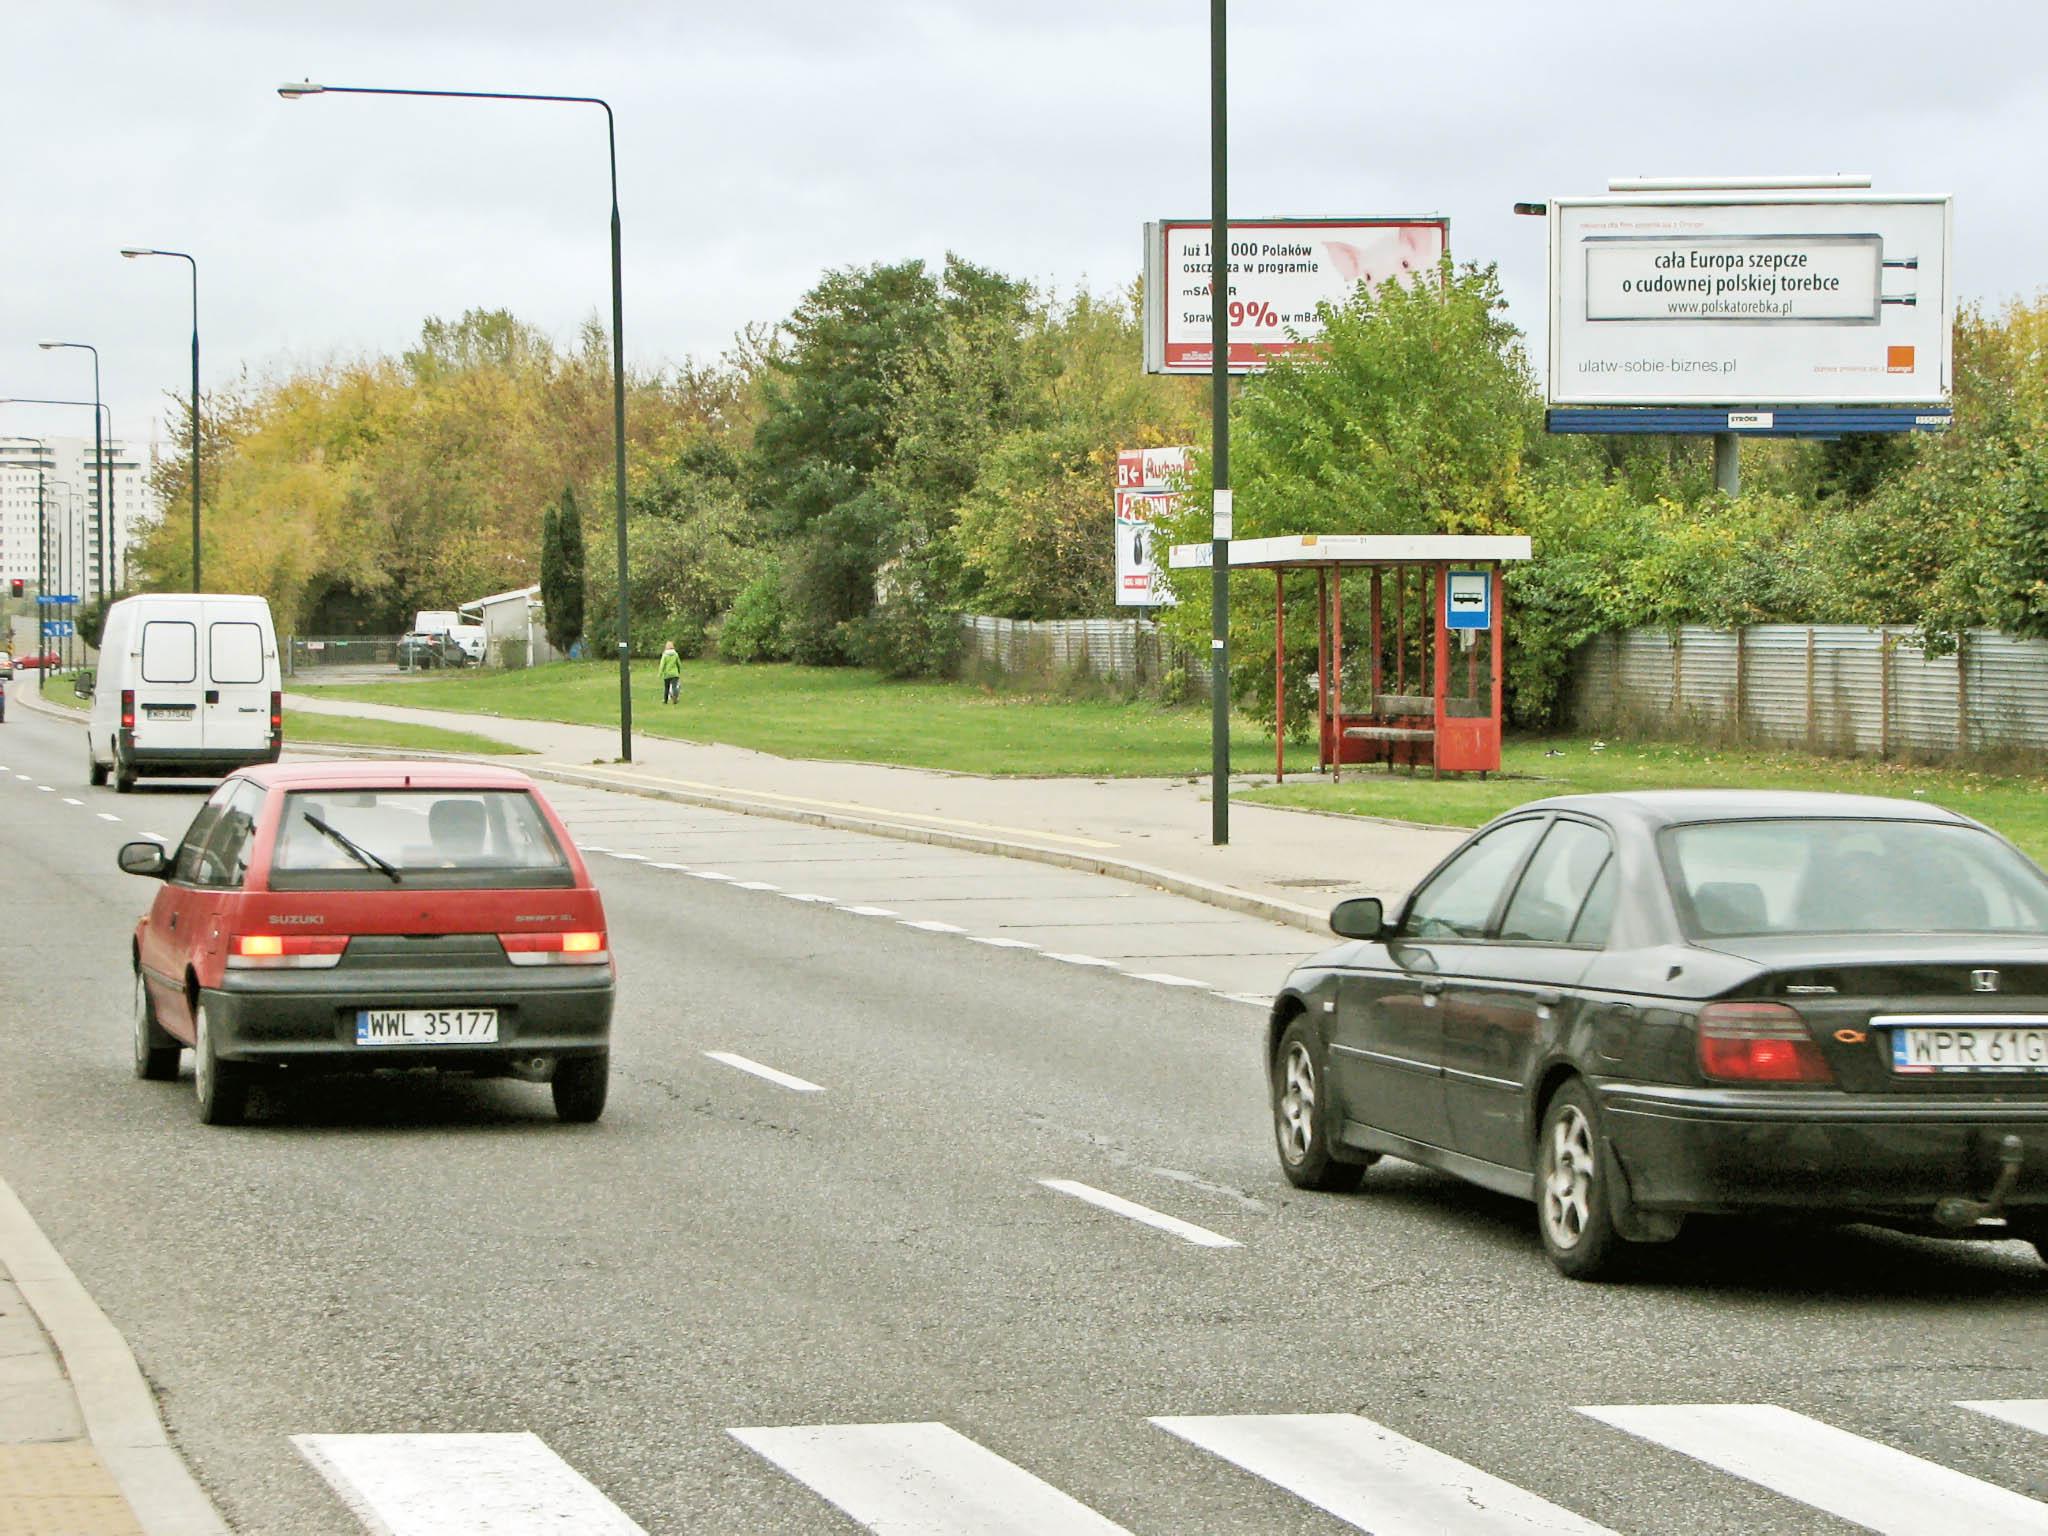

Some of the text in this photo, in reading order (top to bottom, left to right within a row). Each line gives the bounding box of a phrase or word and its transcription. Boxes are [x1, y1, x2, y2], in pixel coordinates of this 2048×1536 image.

[1183, 243, 1201, 257] Już
[1262, 243, 1312, 257] Polaków
[1183, 260, 1319, 274] oszczza w programie
[1654, 250, 1808, 272] cała Europa szepcze
[1622, 273, 1840, 296] o cudownej polskiej torebce
[1183, 311, 1213, 324] Spraw
[1228, 301, 1278, 327] 9%
[1281, 313, 1290, 322] w
[1667, 299, 1793, 316] www.polskatorebka.pl
[1578, 357, 1737, 375] ulatw-sobie-biznes.pl
[268, 914, 325, 925] SUZUKI
[370, 1011, 495, 1037] WWL 35177
[1910, 1031, 2048, 1063] WPR 61G
